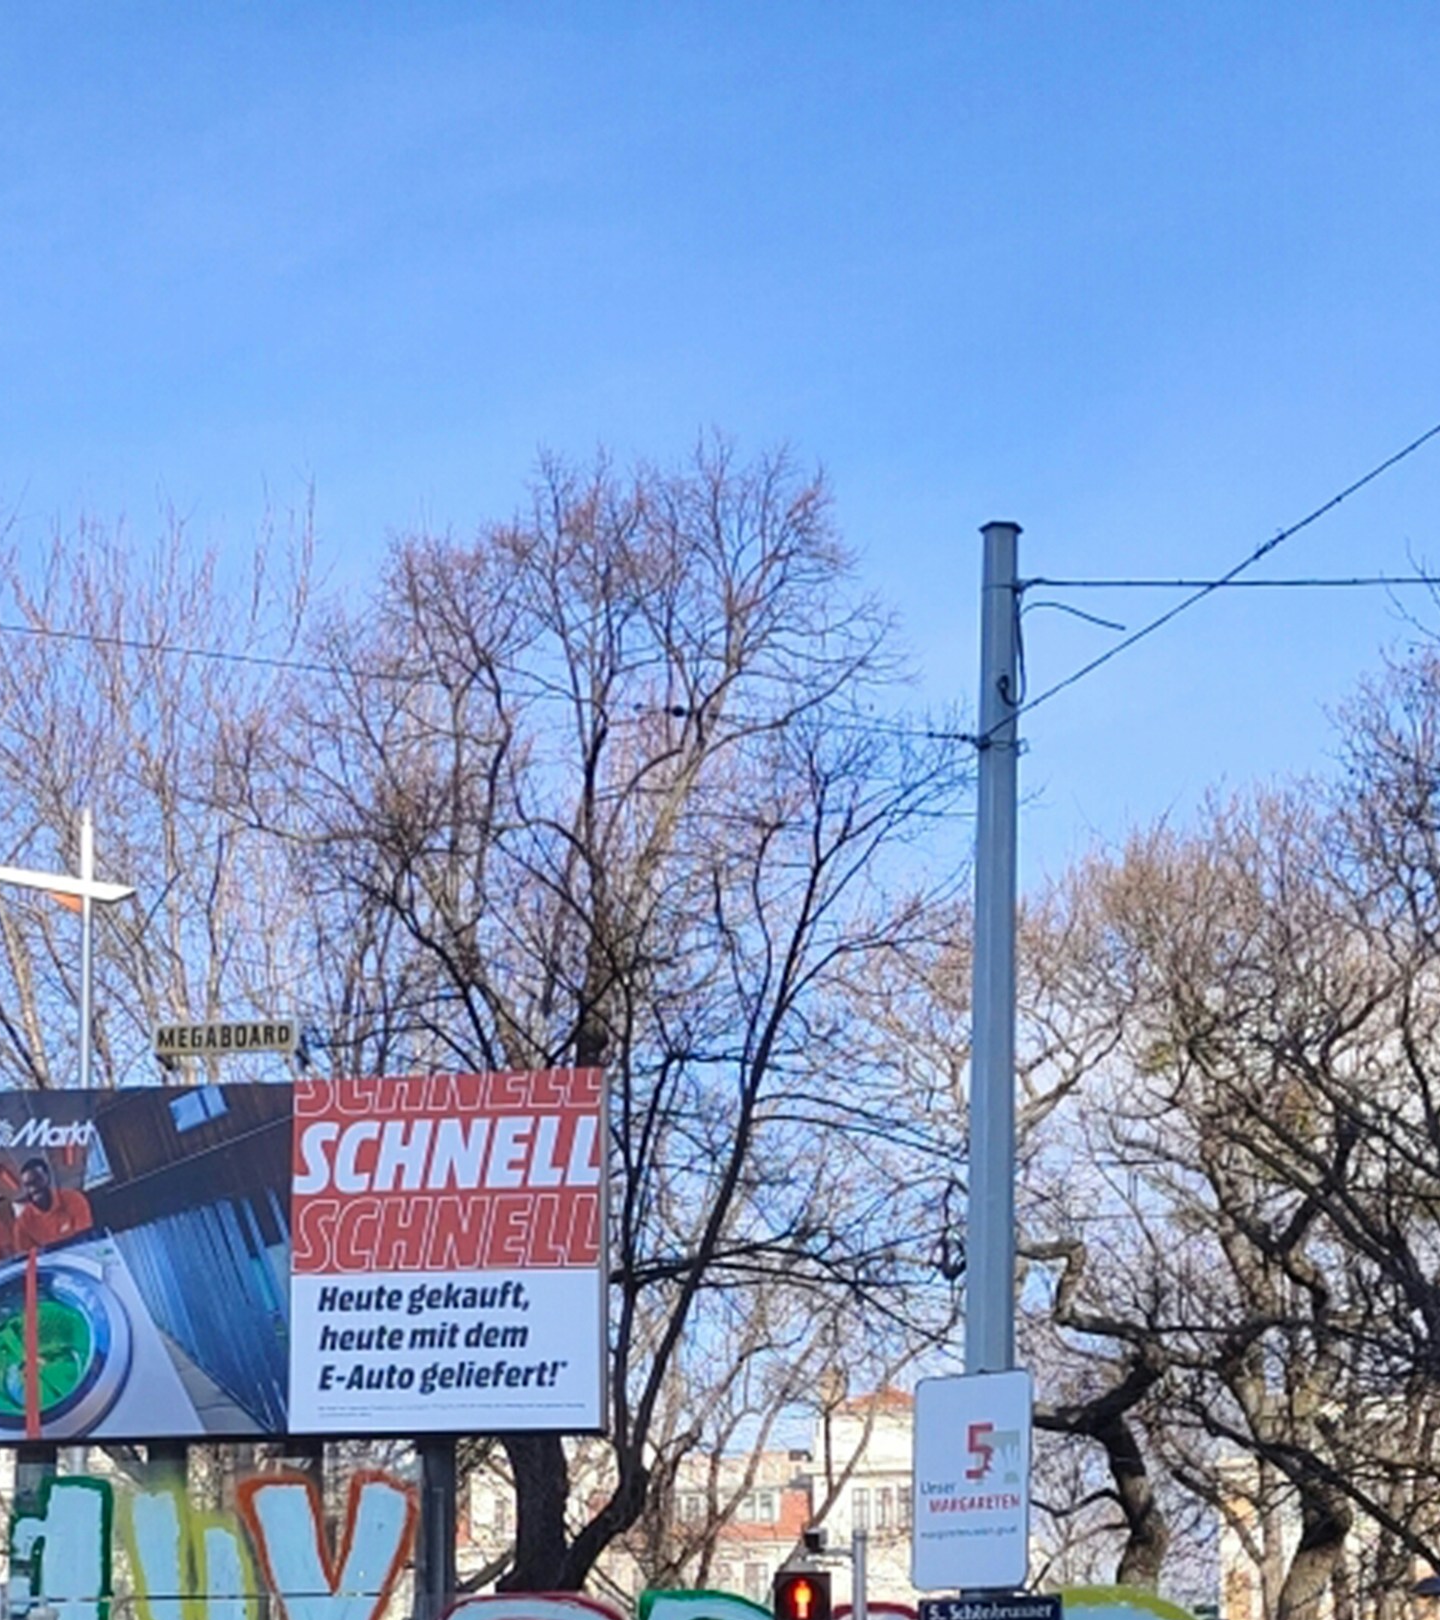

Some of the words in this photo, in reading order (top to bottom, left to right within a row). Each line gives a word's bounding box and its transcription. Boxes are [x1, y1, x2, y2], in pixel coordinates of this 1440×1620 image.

[159, 1024, 291, 1051] MEGABOARD
[9, 1119, 94, 1149] Markt
[293, 1115, 601, 1194] SCHNELL
[291, 1193, 600, 1274] SCHNELL
[318, 1286, 402, 1312] Heute
[407, 1281, 530, 1315] gekauft,
[319, 1324, 402, 1351] heute
[408, 1322, 459, 1349] mit
[463, 1322, 529, 1348] dem
[318, 1364, 415, 1391] E-Auto
[929, 1494, 1021, 1513] MARGARETEN
